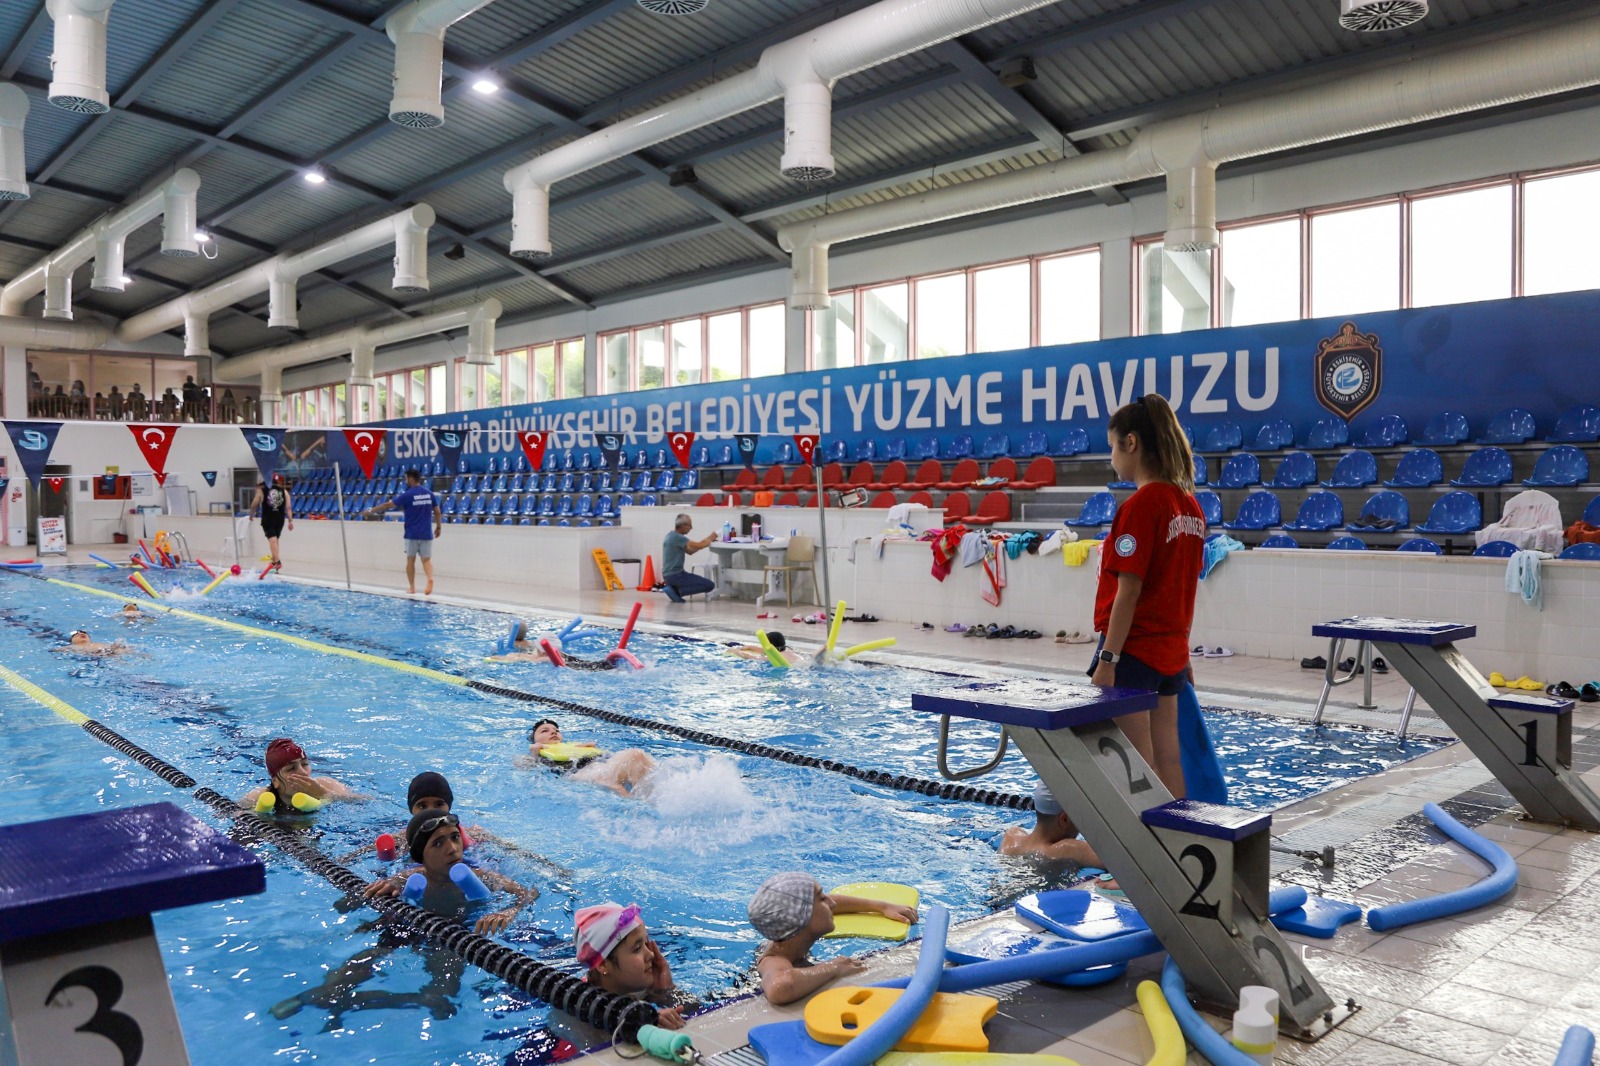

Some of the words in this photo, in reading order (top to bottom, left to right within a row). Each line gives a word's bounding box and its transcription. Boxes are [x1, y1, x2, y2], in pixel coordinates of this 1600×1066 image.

[394, 414, 482, 463] ESKİŞİR
[646, 375, 831, 444] BELEDİYESİ
[843, 369, 1002, 432] YÜZME
[1021, 347, 1280, 422] HAVUZU
[1097, 736, 1153, 795] 2
[1518, 719, 1543, 768] 1
[1178, 843, 1220, 921] 2
[1252, 934, 1314, 1007] 2
[45, 964, 144, 1066] 3
